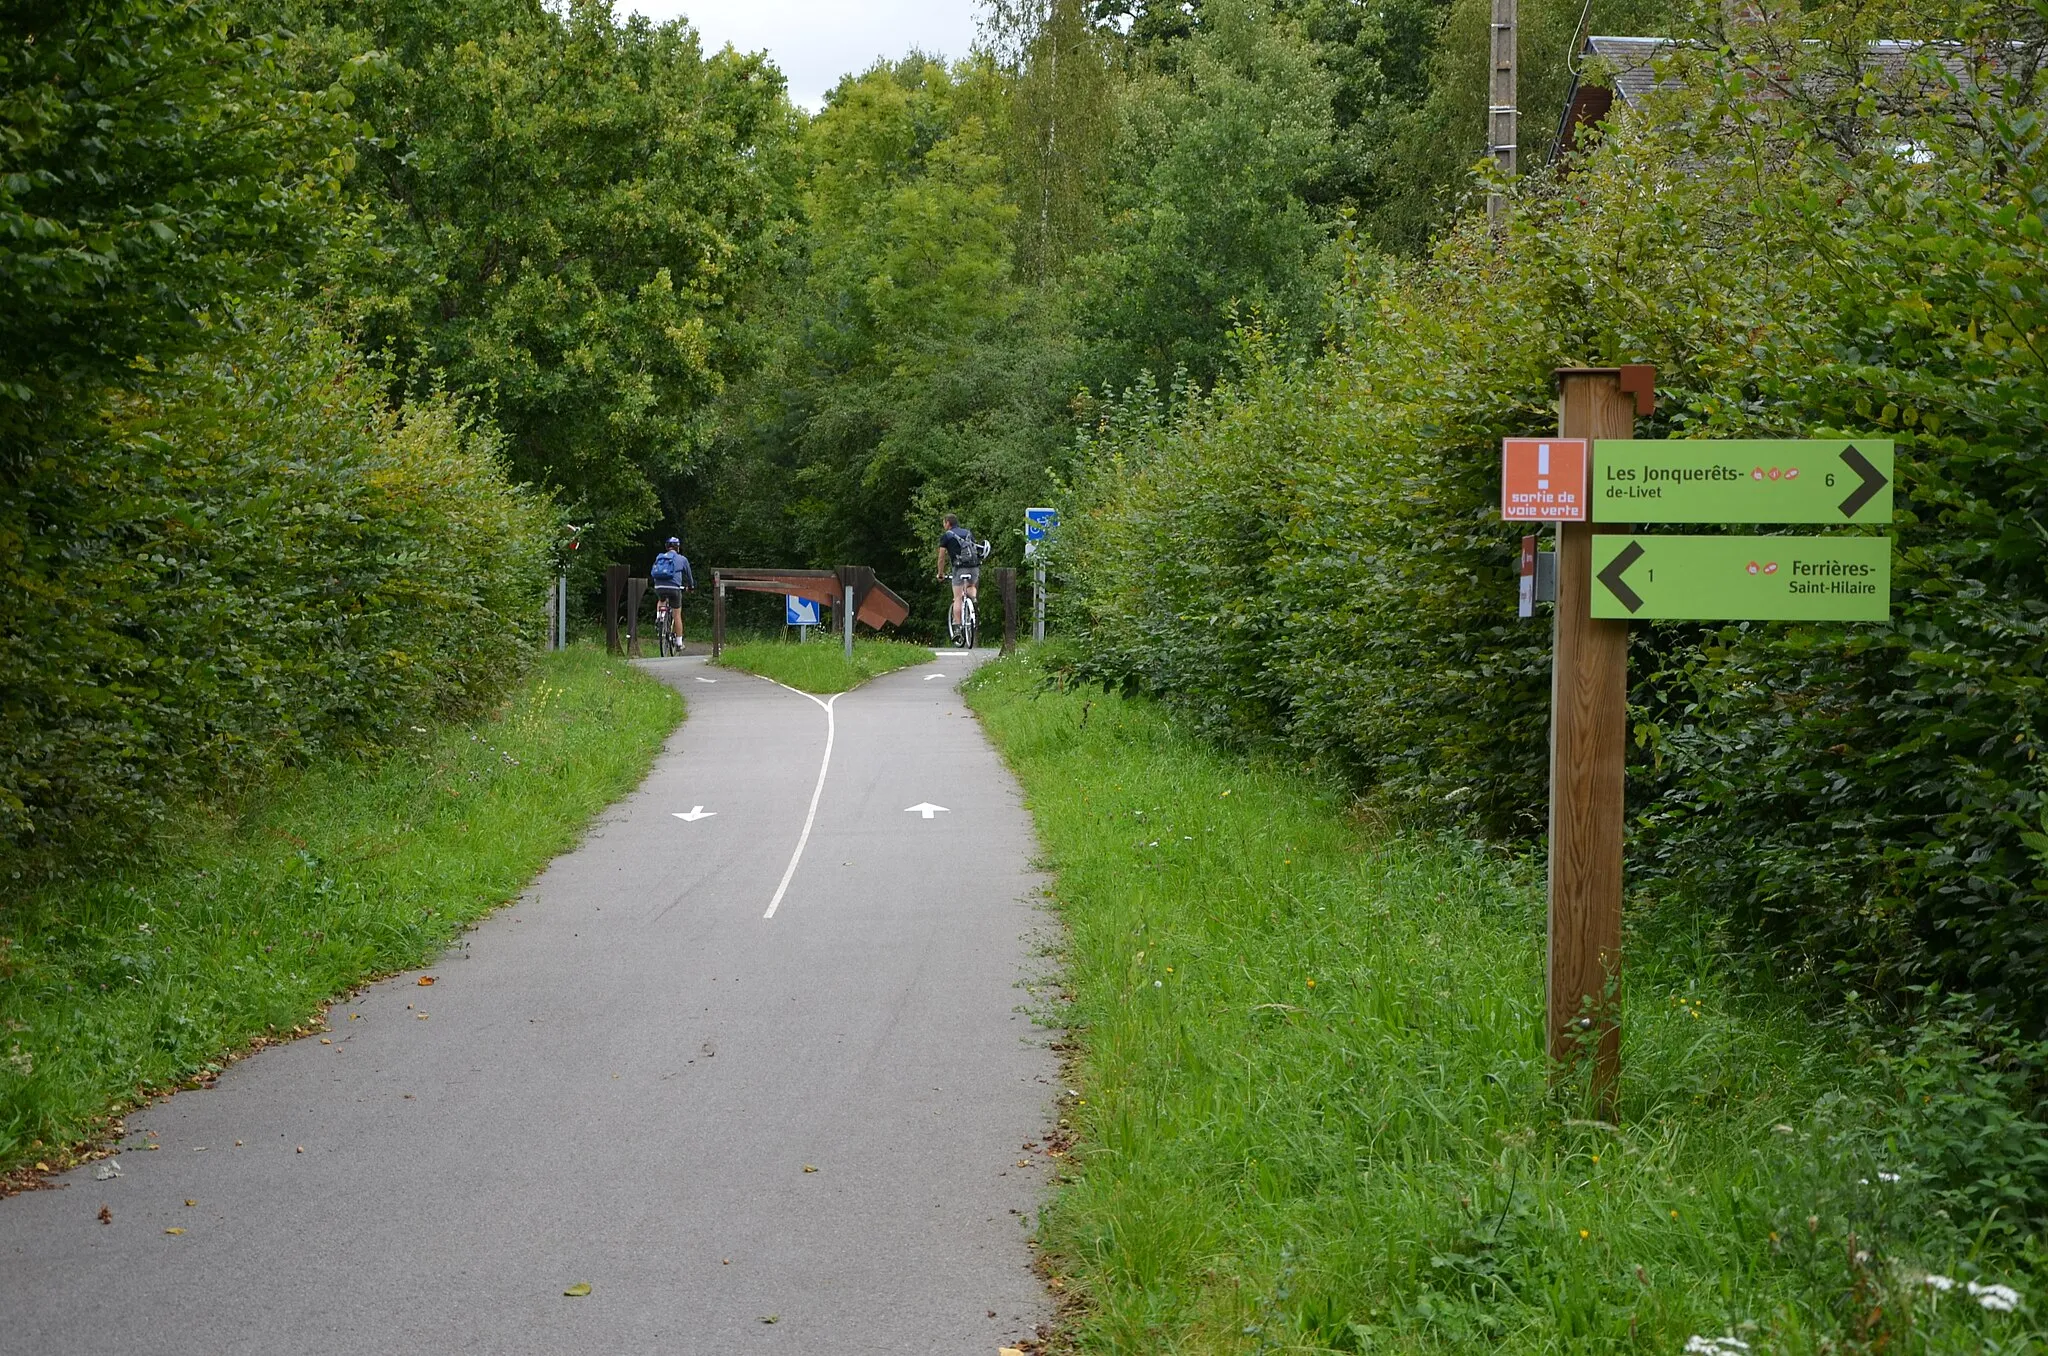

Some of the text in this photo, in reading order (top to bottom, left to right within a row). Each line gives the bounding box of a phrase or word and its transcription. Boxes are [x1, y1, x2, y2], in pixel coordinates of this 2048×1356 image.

[1607, 464, 1745, 484] Les Jonquerêts-
[1825, 473, 1835, 487] 6
[1511, 490, 1575, 503] sortie de
[1606, 485, 1662, 498] de-Livet
[1507, 503, 1579, 516] voie verte
[1792, 560, 1876, 577] Ferrières-
[1648, 569, 1654, 583] 1
[1789, 580, 1876, 594] Saint-Hilaire
